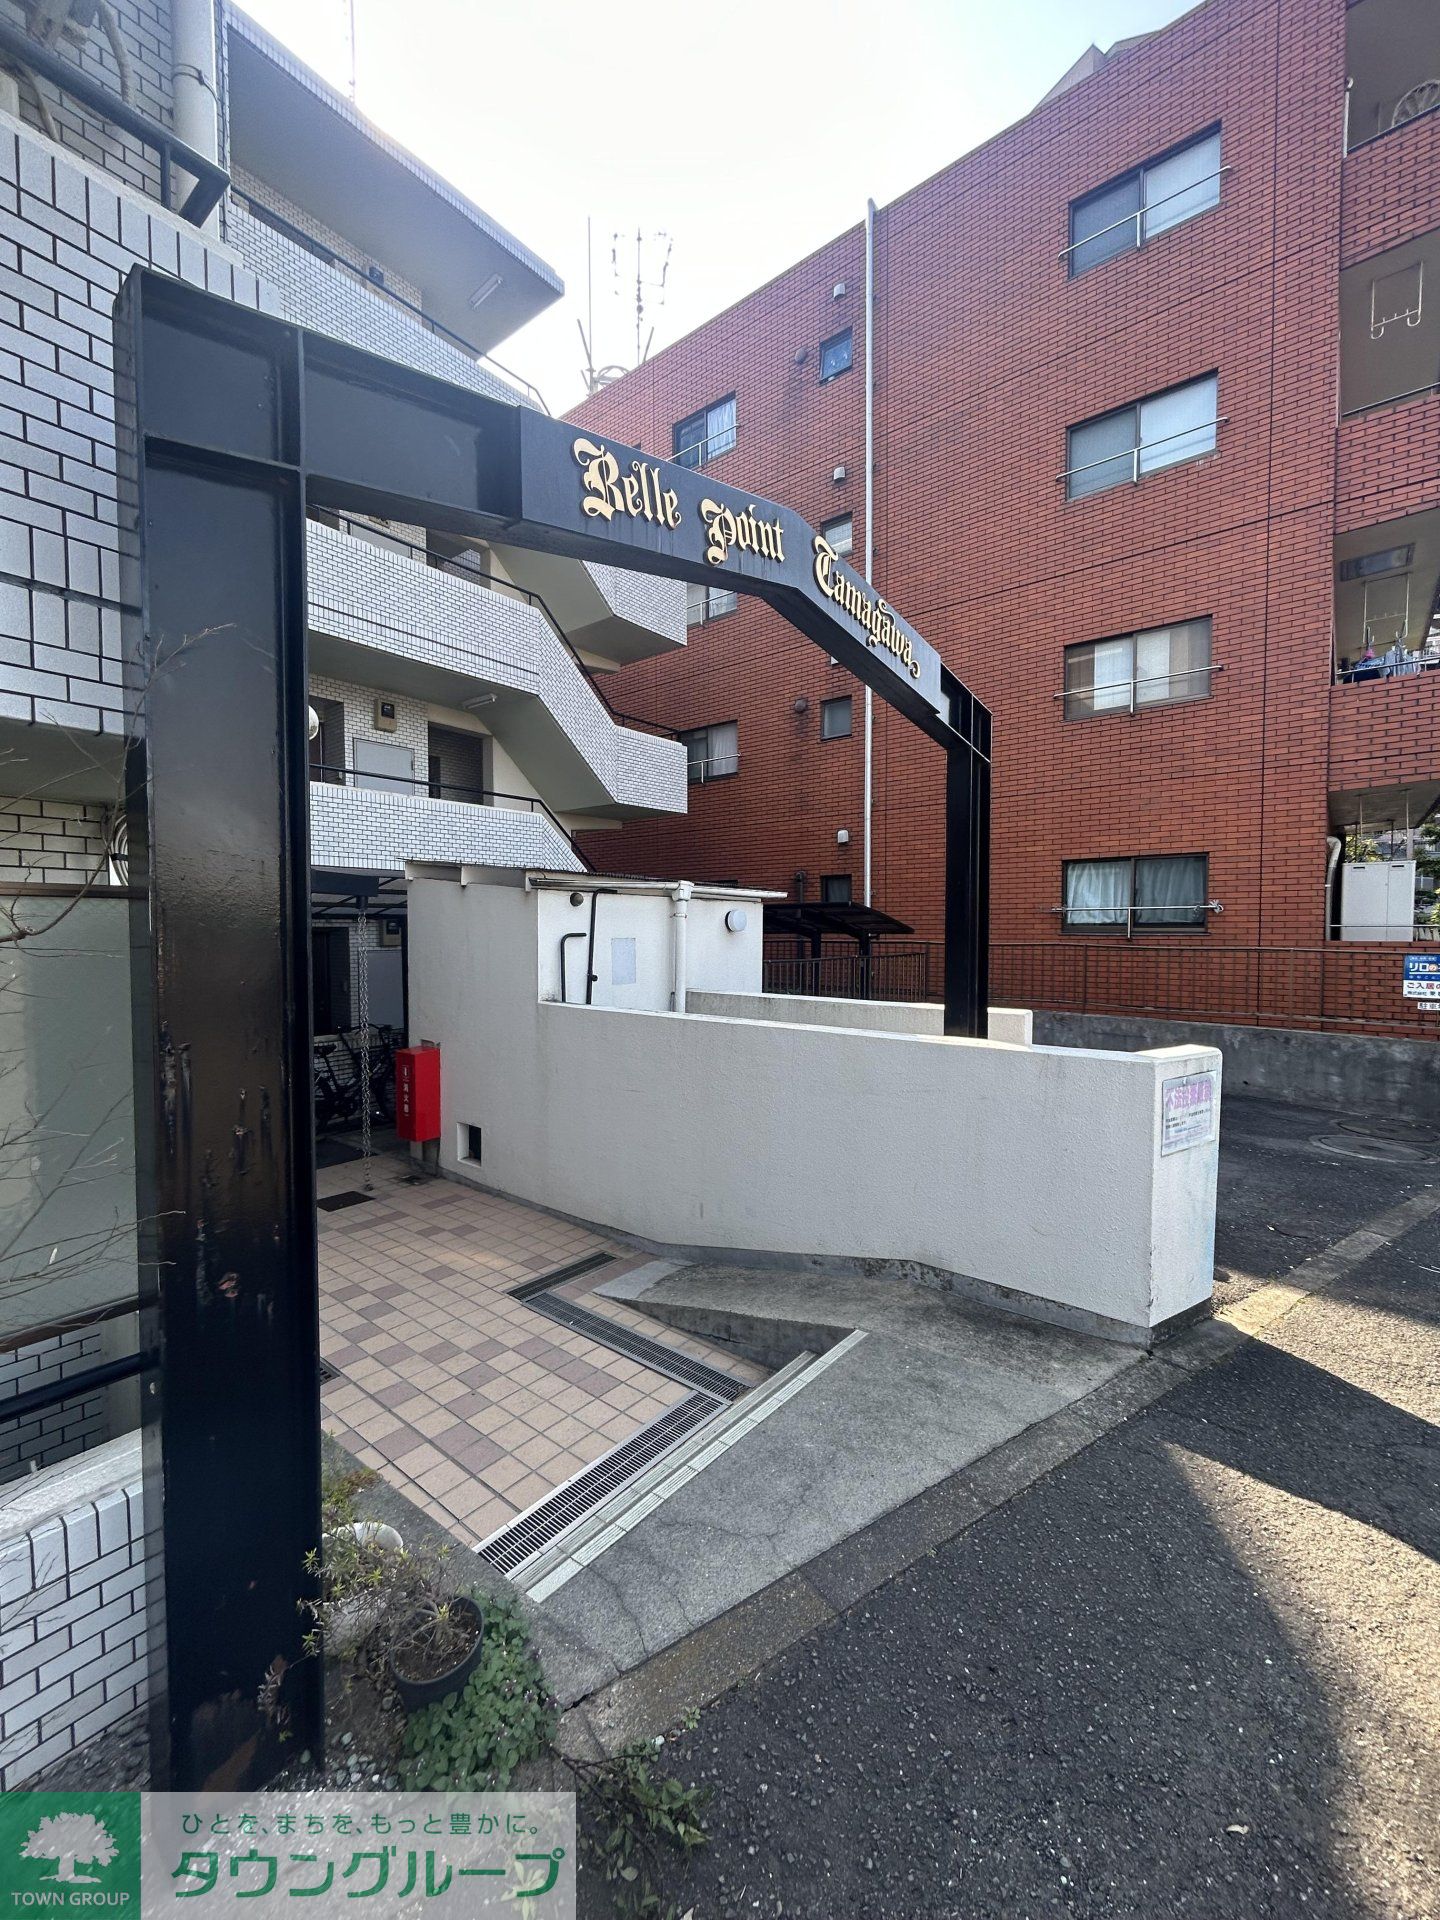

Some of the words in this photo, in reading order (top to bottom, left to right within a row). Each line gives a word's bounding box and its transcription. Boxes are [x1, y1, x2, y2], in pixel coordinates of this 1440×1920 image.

[572, 438, 682, 530] Belle
[700, 498, 786, 566] Point
[812, 535, 922, 679] Tamagawa
